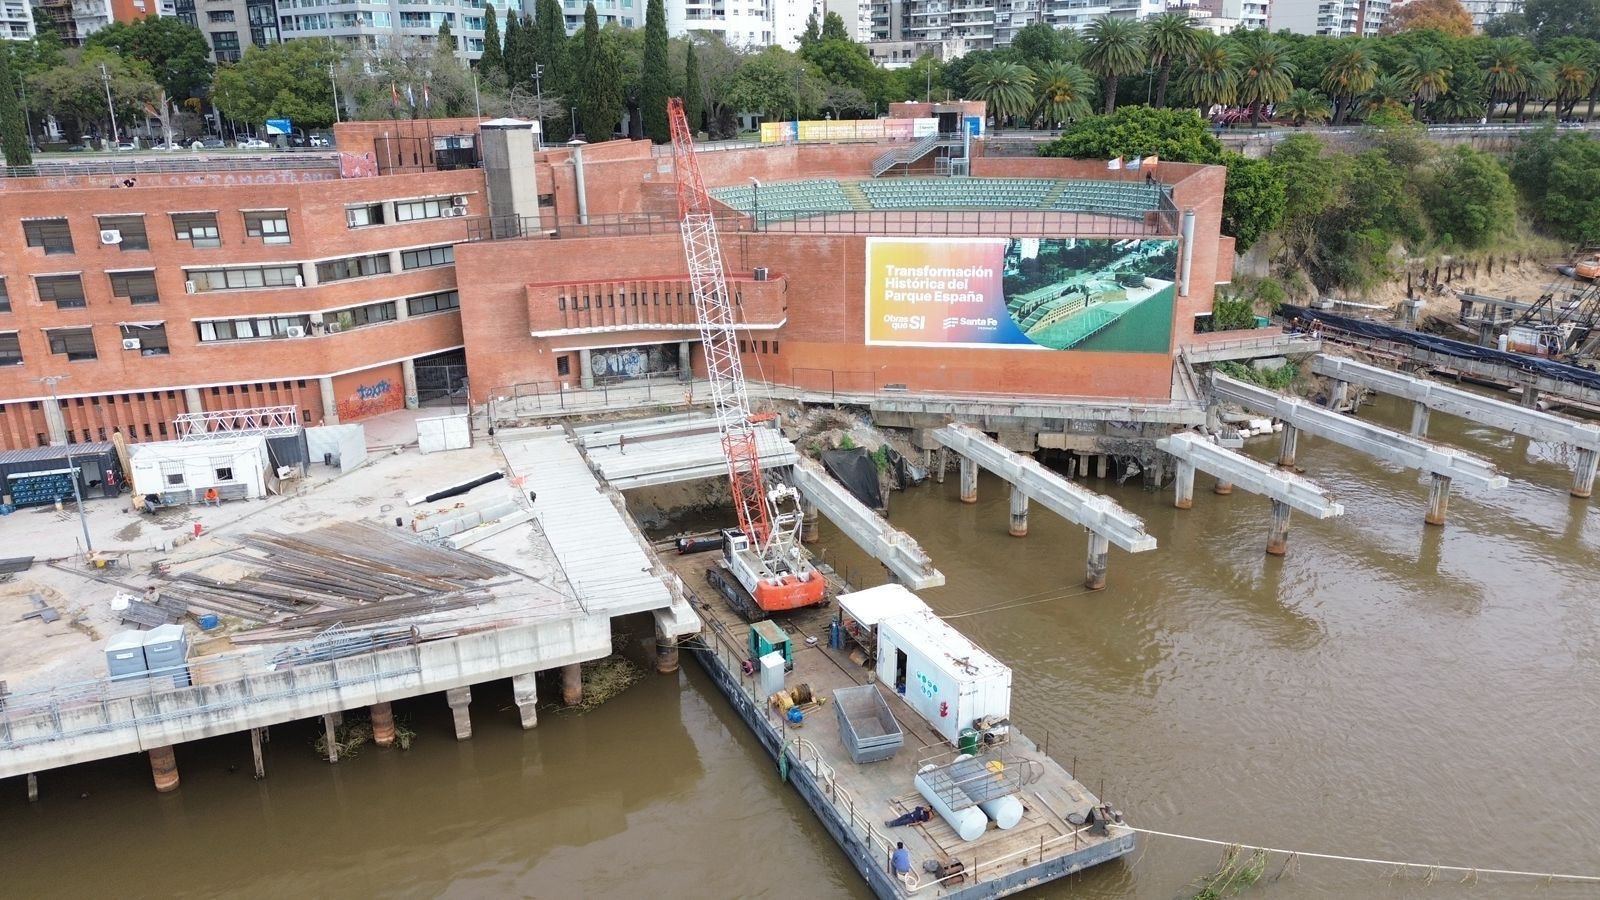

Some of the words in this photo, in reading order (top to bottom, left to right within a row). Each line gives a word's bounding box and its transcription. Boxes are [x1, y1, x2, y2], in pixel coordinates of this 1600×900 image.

[886, 265, 993, 277] Transformación
[885, 277, 945, 289] Histórica
[947, 278, 969, 290] del
[885, 290, 932, 303] Parque
[934, 291, 983, 304] España
[883, 314, 908, 322] Obras
[960, 317, 986, 326] Santa
[987, 317, 998, 326] Fe
[892, 322, 908, 330] que
